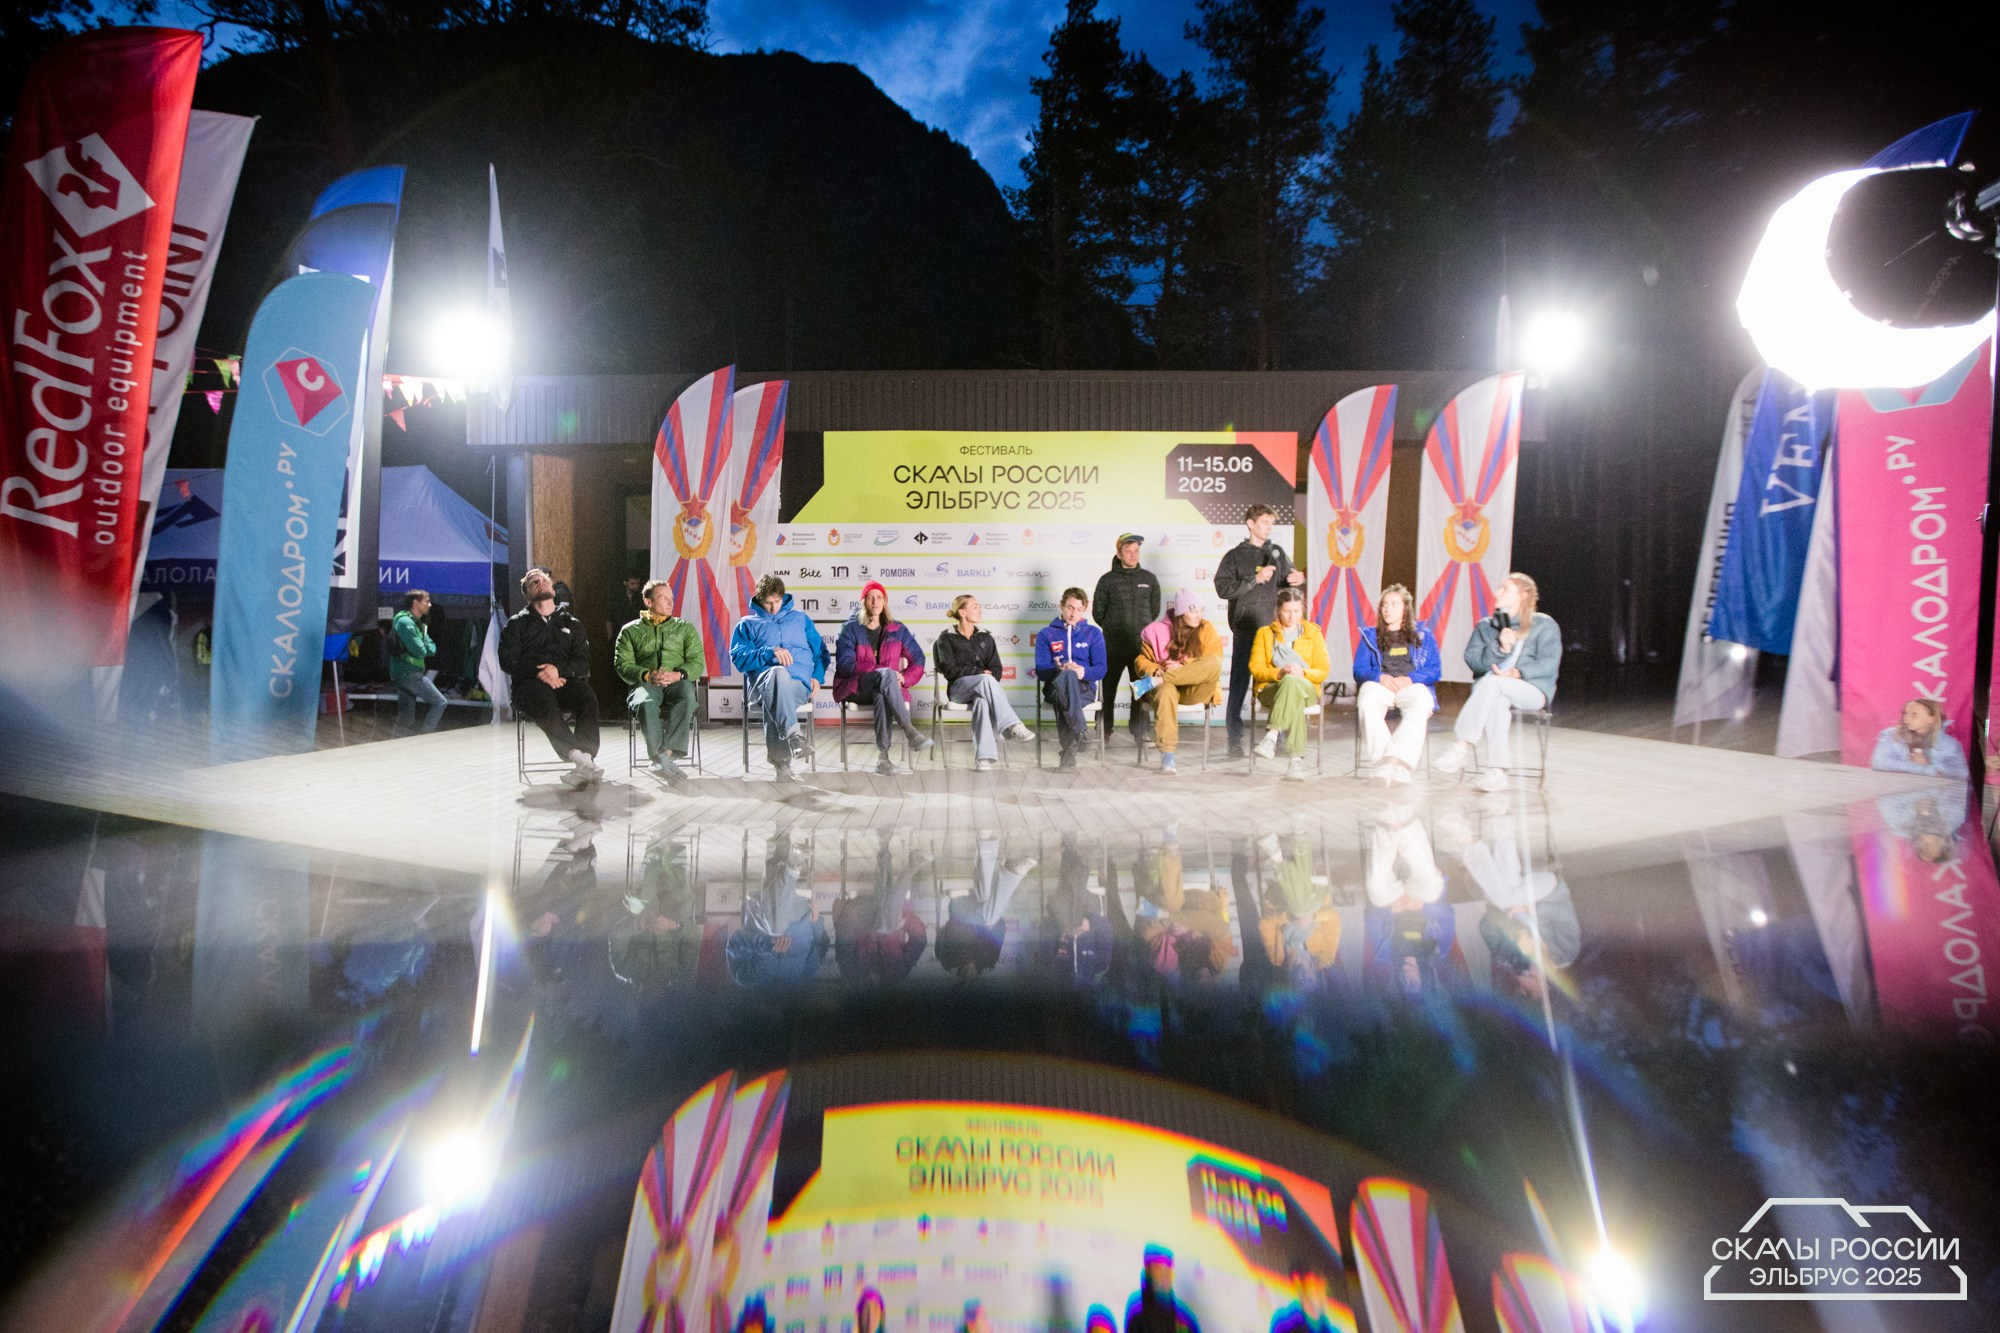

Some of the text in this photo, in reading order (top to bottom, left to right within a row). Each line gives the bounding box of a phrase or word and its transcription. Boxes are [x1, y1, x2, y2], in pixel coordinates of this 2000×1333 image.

[0, 229, 114, 538] RedFox
[94, 249, 148, 546] outdoor equipment
[959, 445, 1033, 456] ФЕСТИВАЛЬ
[893, 465, 1100, 484] СКАЛЫ РОССИИ
[1178, 477, 1227, 493] 2025
[905, 491, 1086, 510] ЭЛЬБРУС 2025
[800, 567, 822, 579] Bite
[957, 569, 991, 578] BARKLI
[925, 602, 951, 611] BARK
[815, 701, 841, 710] BARK
